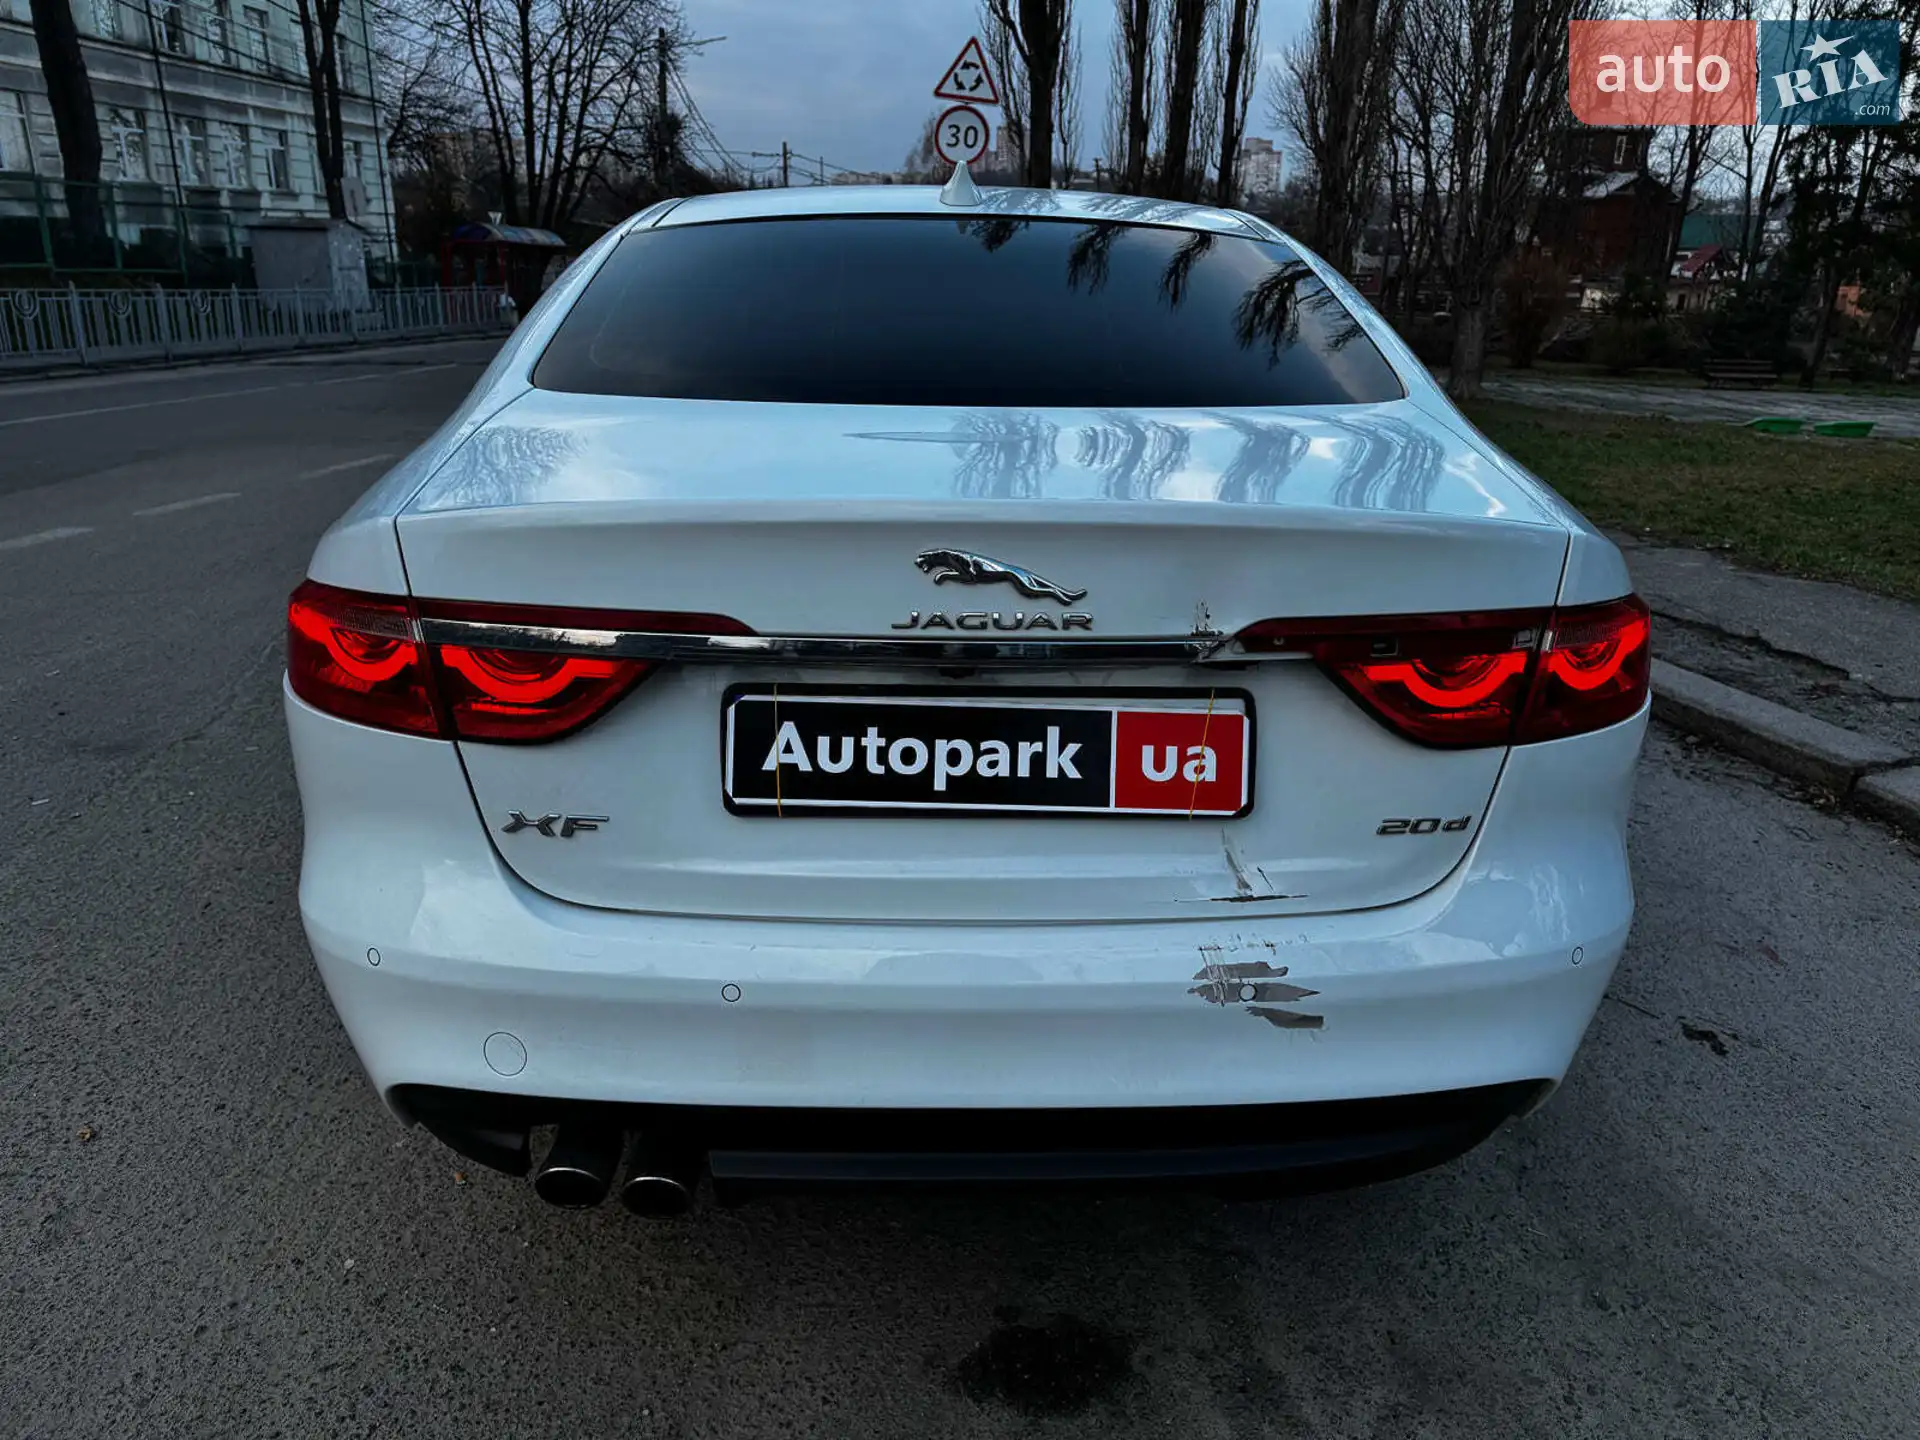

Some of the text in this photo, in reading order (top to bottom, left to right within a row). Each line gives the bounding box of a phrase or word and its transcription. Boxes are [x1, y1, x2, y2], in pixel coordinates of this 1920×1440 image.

[945, 123, 979, 149] 30
[891, 610, 1094, 632] JAGUAR
[762, 721, 1217, 791] Autopark ua
[501, 809, 610, 838] XF
[1375, 814, 1472, 836] 20d
